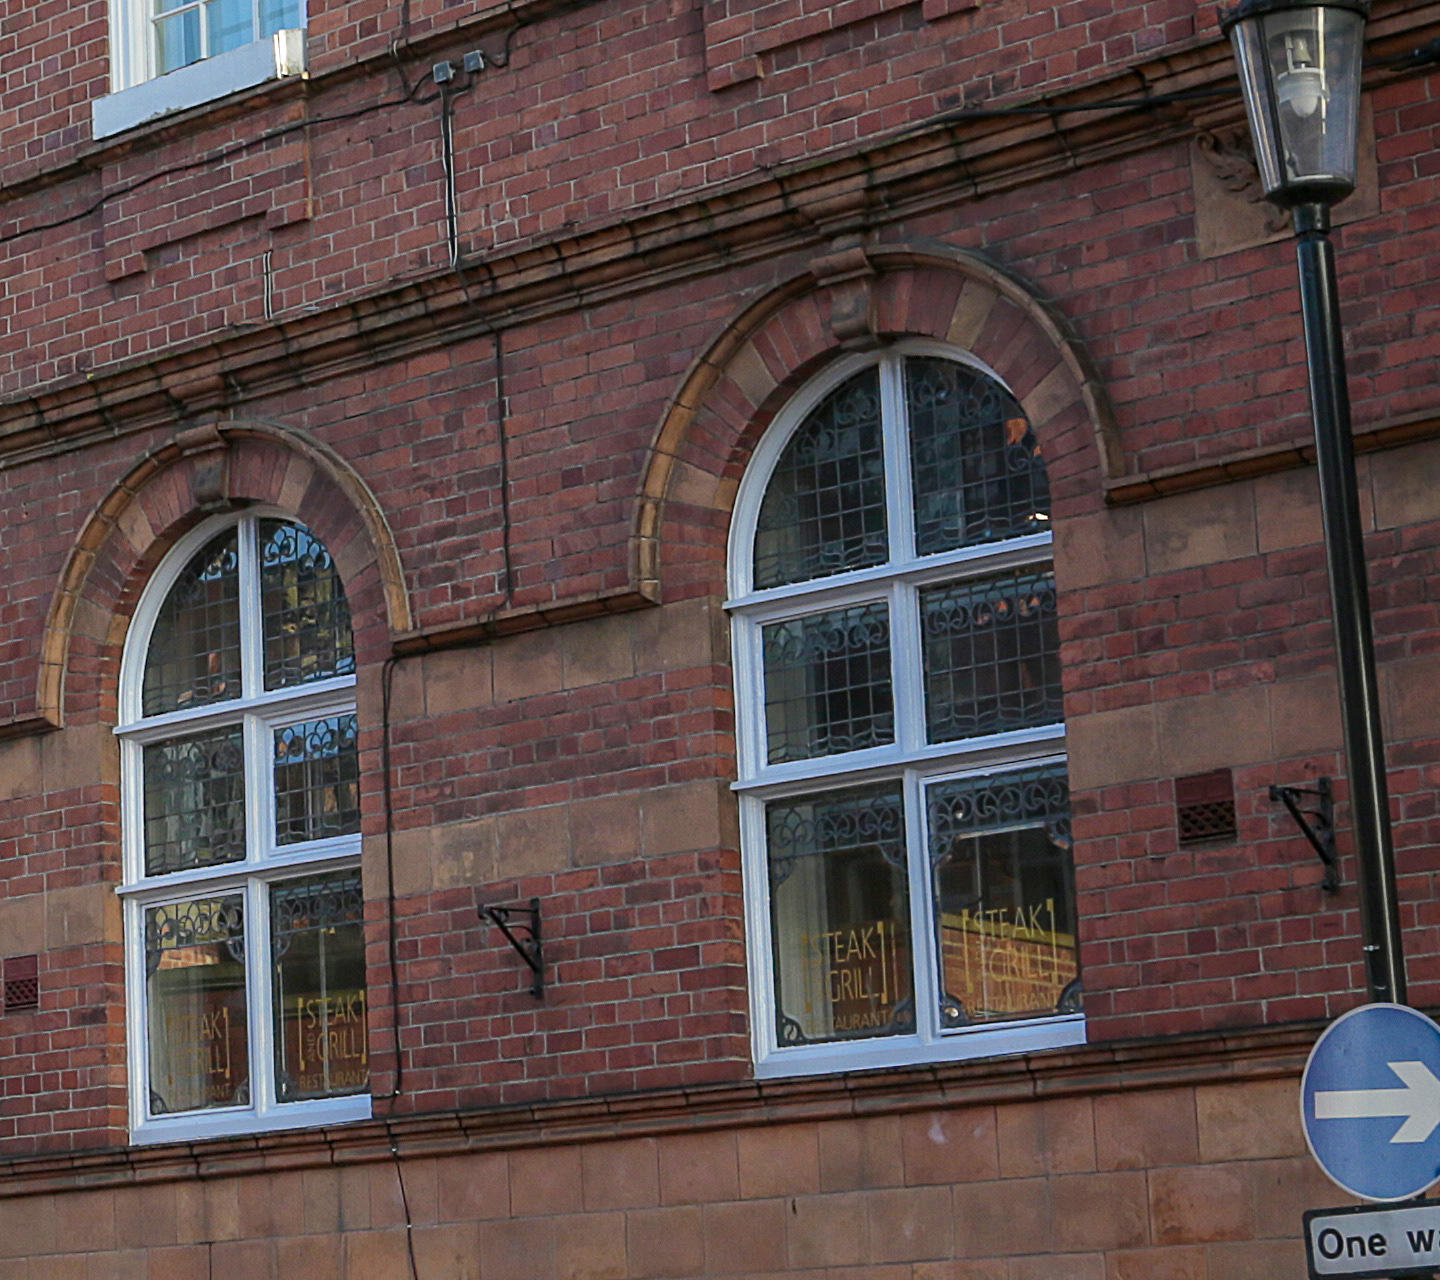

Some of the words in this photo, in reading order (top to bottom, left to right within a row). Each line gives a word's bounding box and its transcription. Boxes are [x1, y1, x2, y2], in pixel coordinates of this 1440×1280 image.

[306, 995, 359, 1029] STEAK
[317, 1028, 360, 1060] GRILL
[1318, 1228, 1387, 1259] One
